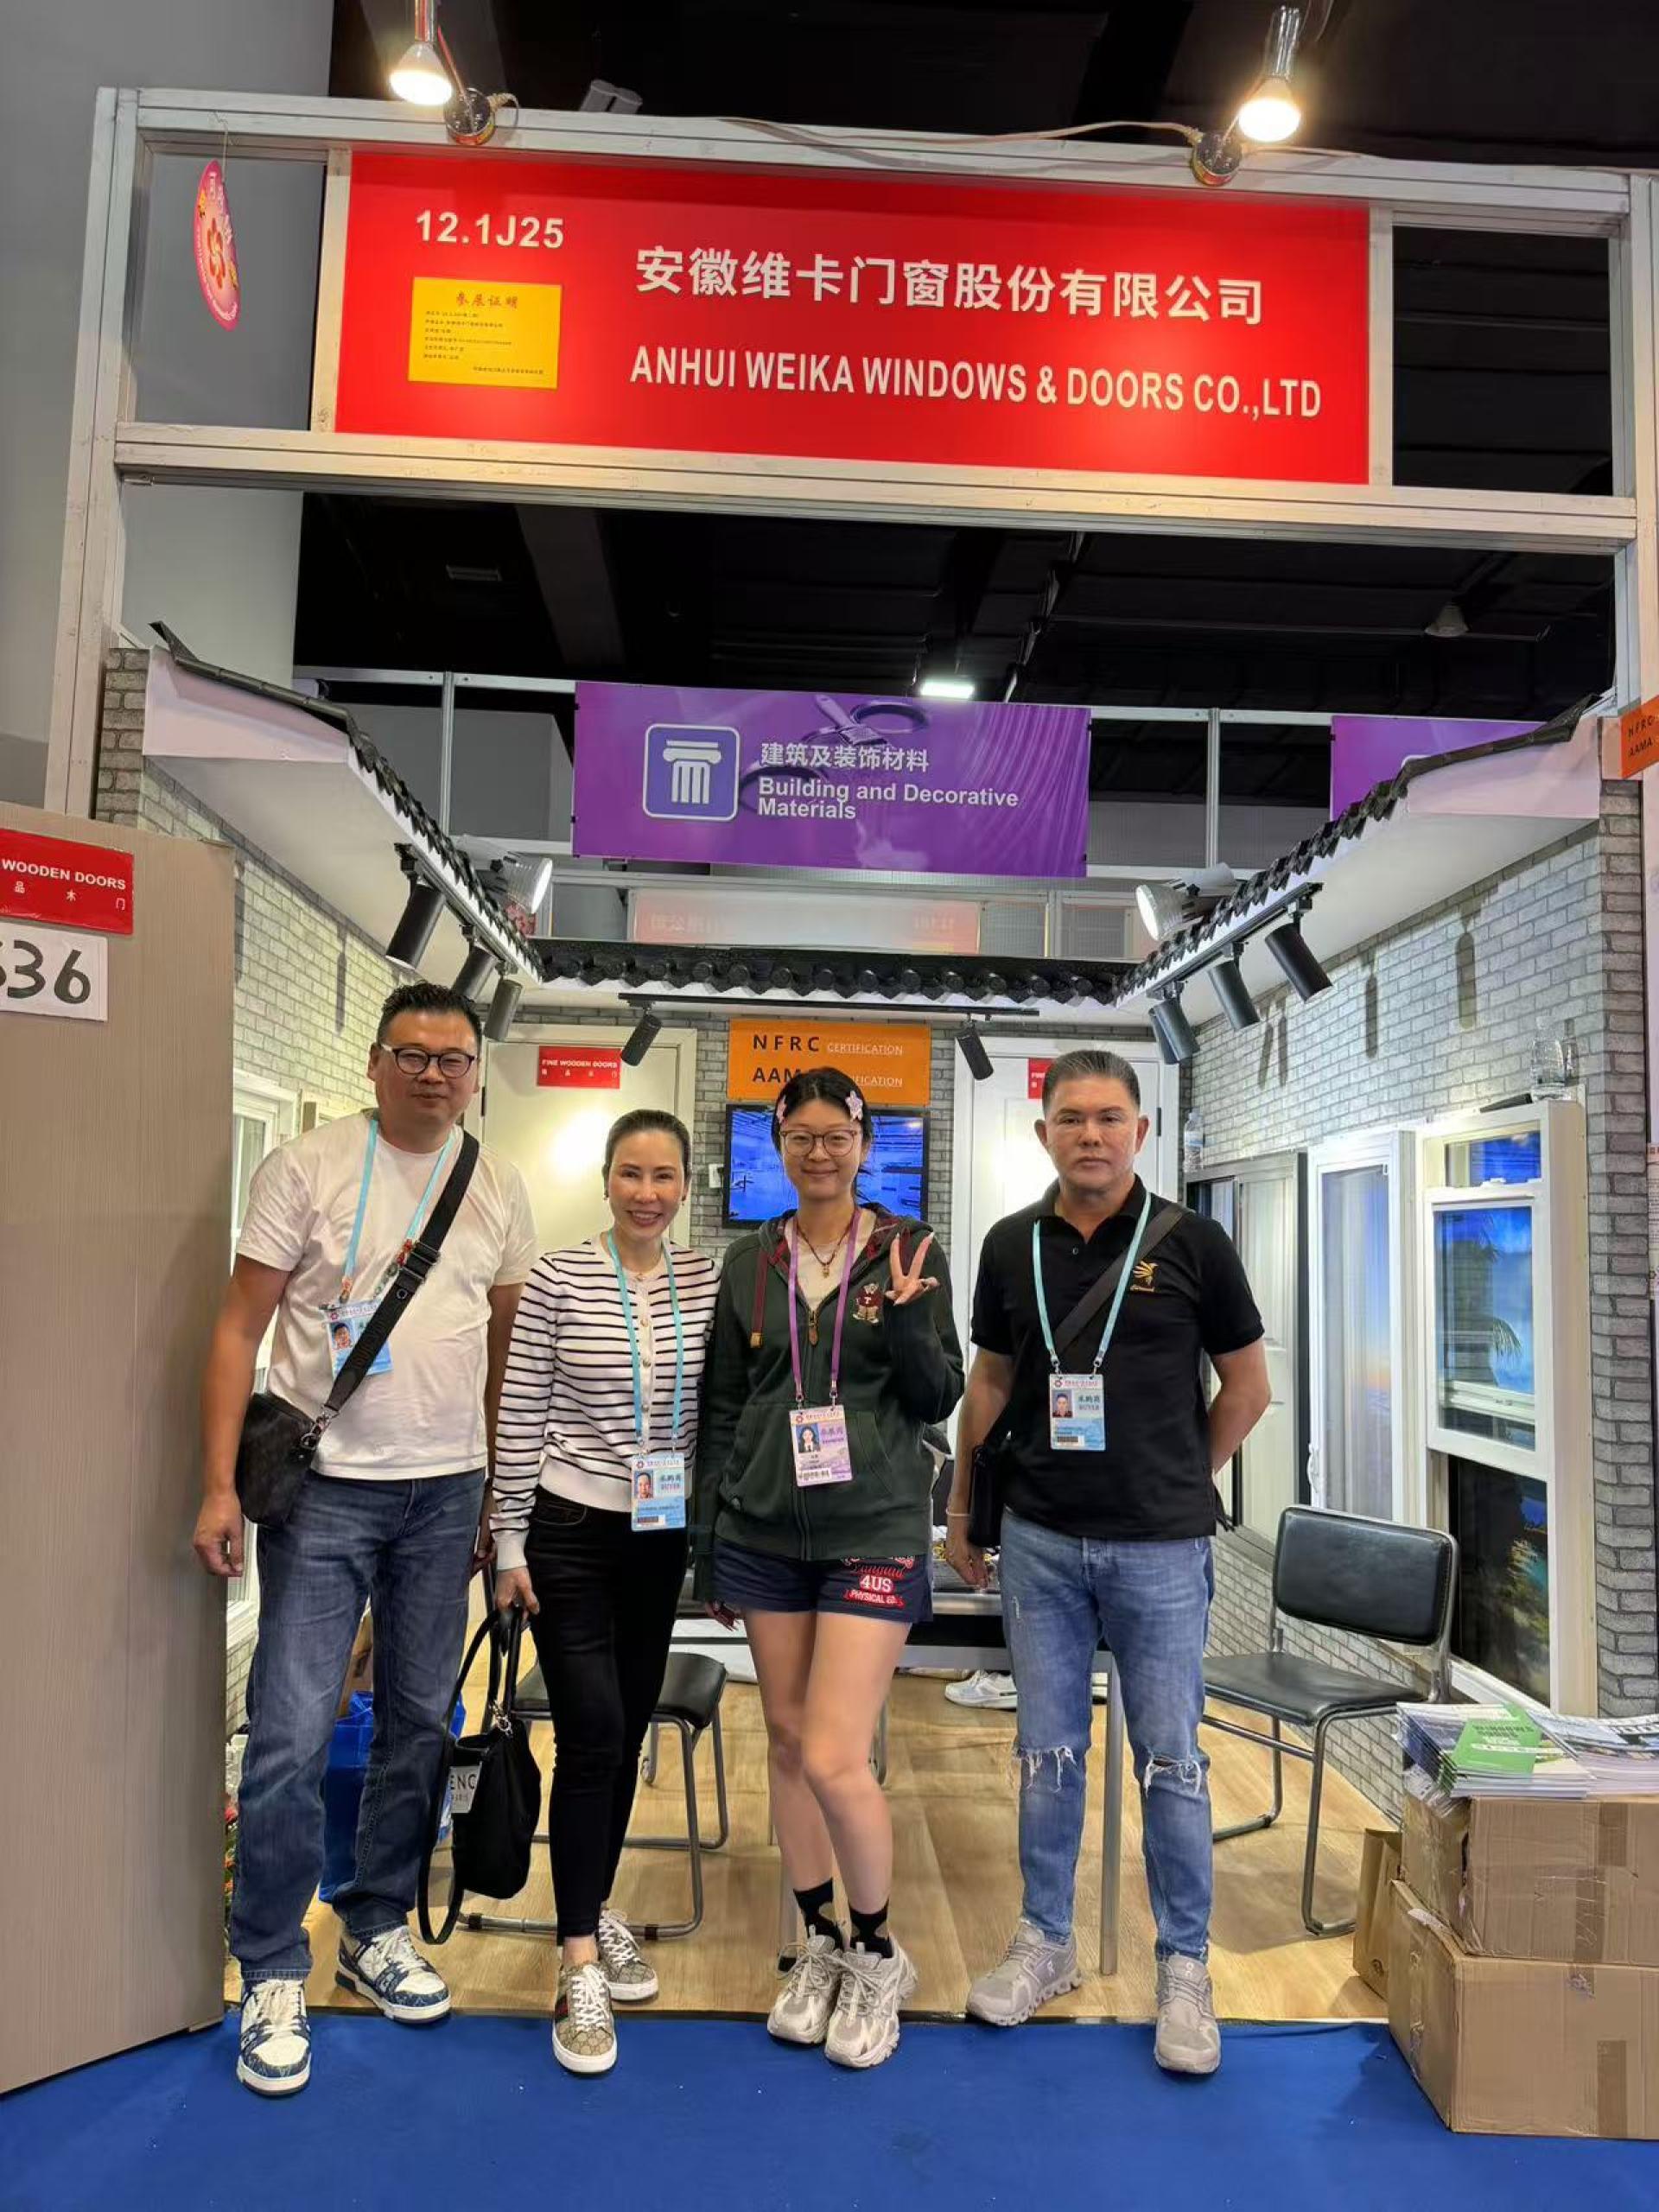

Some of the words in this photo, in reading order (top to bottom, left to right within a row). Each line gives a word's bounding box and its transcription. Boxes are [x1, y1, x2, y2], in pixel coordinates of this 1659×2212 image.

[416, 210, 564, 249] 12.1J25
[636, 245, 1263, 325] 安徽维卡门窗股份有限公司
[630, 345, 735, 388] ANHUI
[745, 349, 855, 393] WEIKA
[863, 357, 1027, 403] WINDOWS
[1036, 365, 1058, 404] &
[1066, 366, 1184, 411] DOORS
[1193, 374, 1323, 421] CO.,LTD
[760, 742, 930, 772] 建筑及装饰材料
[758, 777, 849, 803] Building
[856, 783, 897, 801] and
[904, 784, 1020, 807] Decorative
[758, 798, 856, 819] Materials
[2, 858, 71, 881] WOODEN
[74, 871, 126, 891] DOORS
[0, 939, 92, 1004] 36
[753, 1034, 820, 1052] NFRC
[827, 1042, 904, 1056] CERTIFICATION
[753, 1067, 802, 1084] AAM
[860, 1574, 893, 1592] 4US
